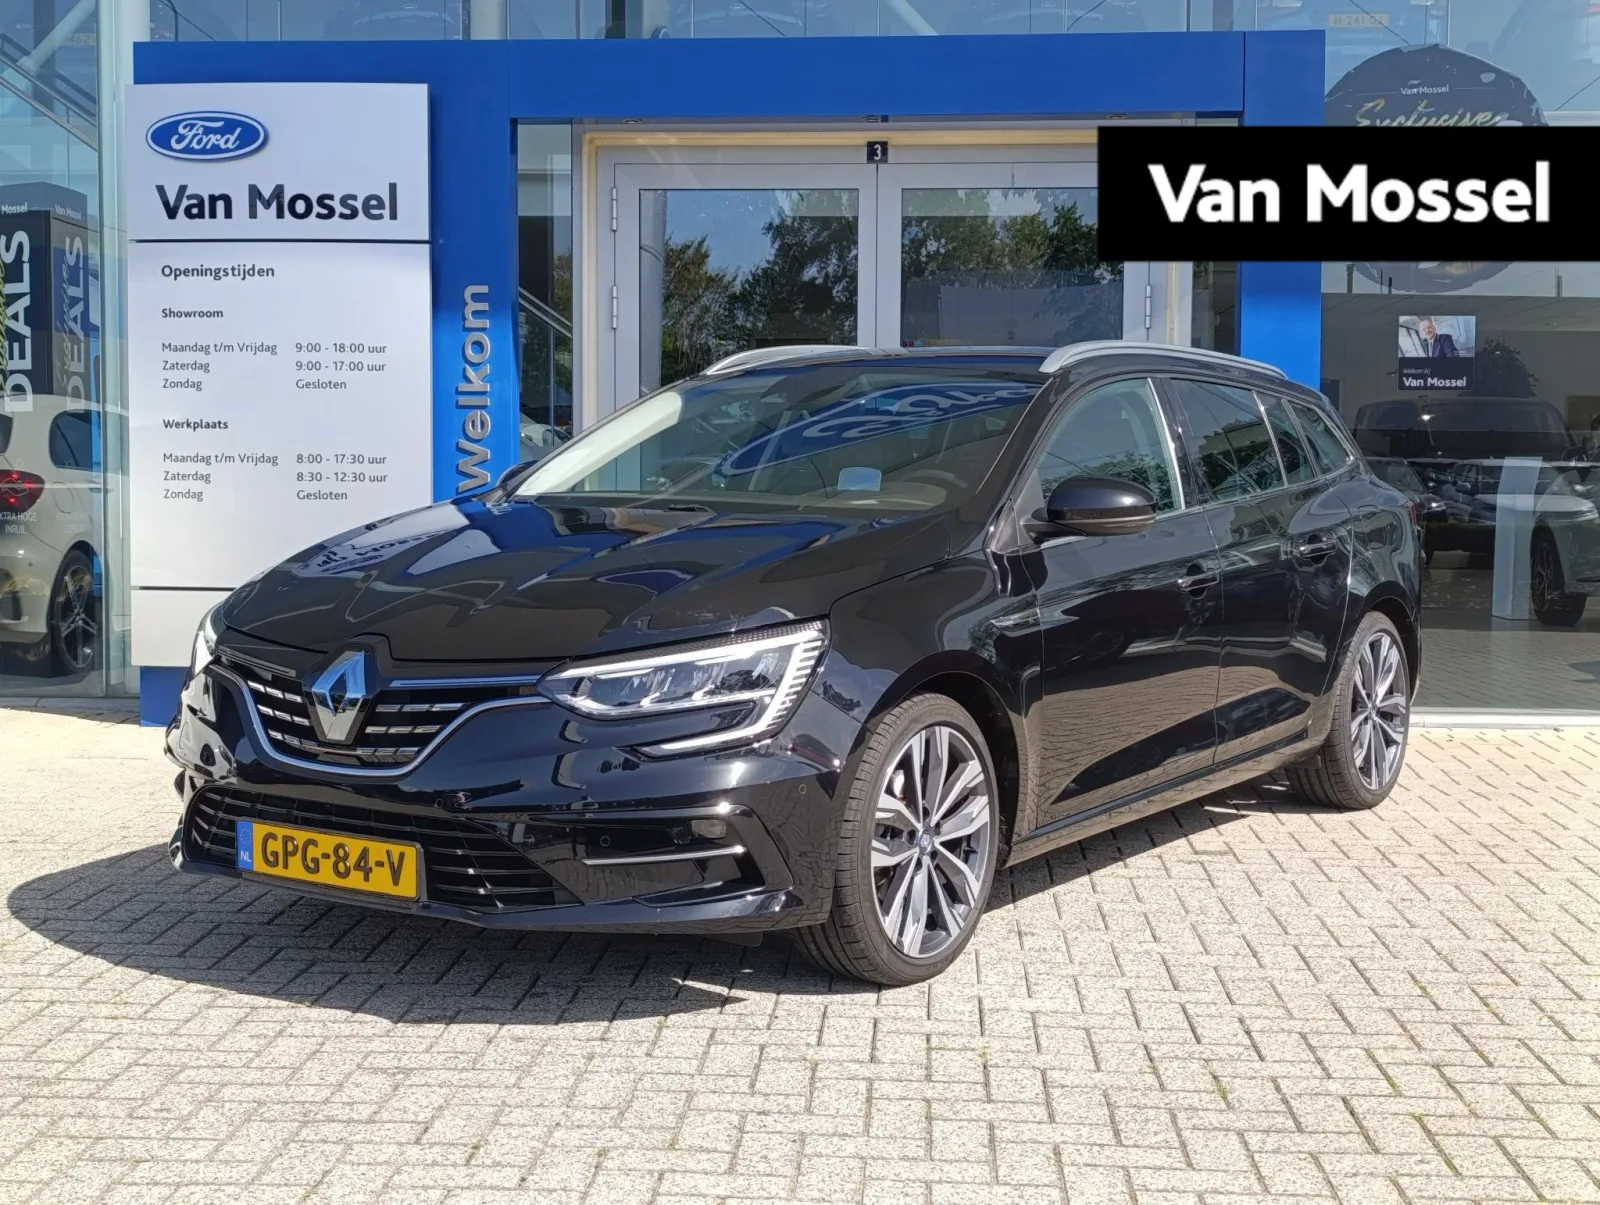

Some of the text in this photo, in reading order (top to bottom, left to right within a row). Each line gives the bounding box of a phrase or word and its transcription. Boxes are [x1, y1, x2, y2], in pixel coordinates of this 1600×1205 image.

[1400, 84, 1450, 96] Van Mossel
[170, 119, 243, 150] Ford
[874, 144, 881, 160] 3
[1, 202, 28, 214] Mossel
[155, 182, 398, 221] Van Mossel
[54, 203, 66, 216] Van
[161, 264, 275, 282] Openingstijden
[161, 307, 224, 319] Showroom
[0, 230, 33, 412] DEALS
[66, 235, 85, 413] DEALS
[162, 342, 278, 356] Maandag t/m Vrijdag
[295, 342, 322, 353] 9:00
[332, 343, 365, 354] 18:00
[368, 345, 387, 354] uur
[162, 360, 211, 374] Zaterdag
[295, 360, 322, 371] 9:00
[332, 360, 364, 372] 17:00
[367, 363, 386, 372] uur
[162, 378, 203, 392] Zondag
[295, 378, 347, 390] Gesloten
[457, 284, 491, 493] Welkom
[1403, 376, 1467, 387] Van Mossel
[162, 418, 229, 432] Werkplaats
[163, 453, 279, 467] Maandag t/m Vrijdag
[296, 453, 323, 465] 8:00
[334, 453, 365, 465] 17:30
[368, 456, 387, 465] uur
[163, 471, 212, 485] Zaterdag
[296, 471, 323, 483] 8:30
[334, 472, 366, 483] 12:30
[369, 474, 388, 483] uur
[163, 489, 204, 503] Zondag
[296, 489, 348, 501] Gesloten
[0, 511, 37, 522] XTRA HOGE
[5, 524, 27, 534] INRUIL
[240, 850, 252, 862] NL
[261, 832, 405, 887] GPG-84-V
